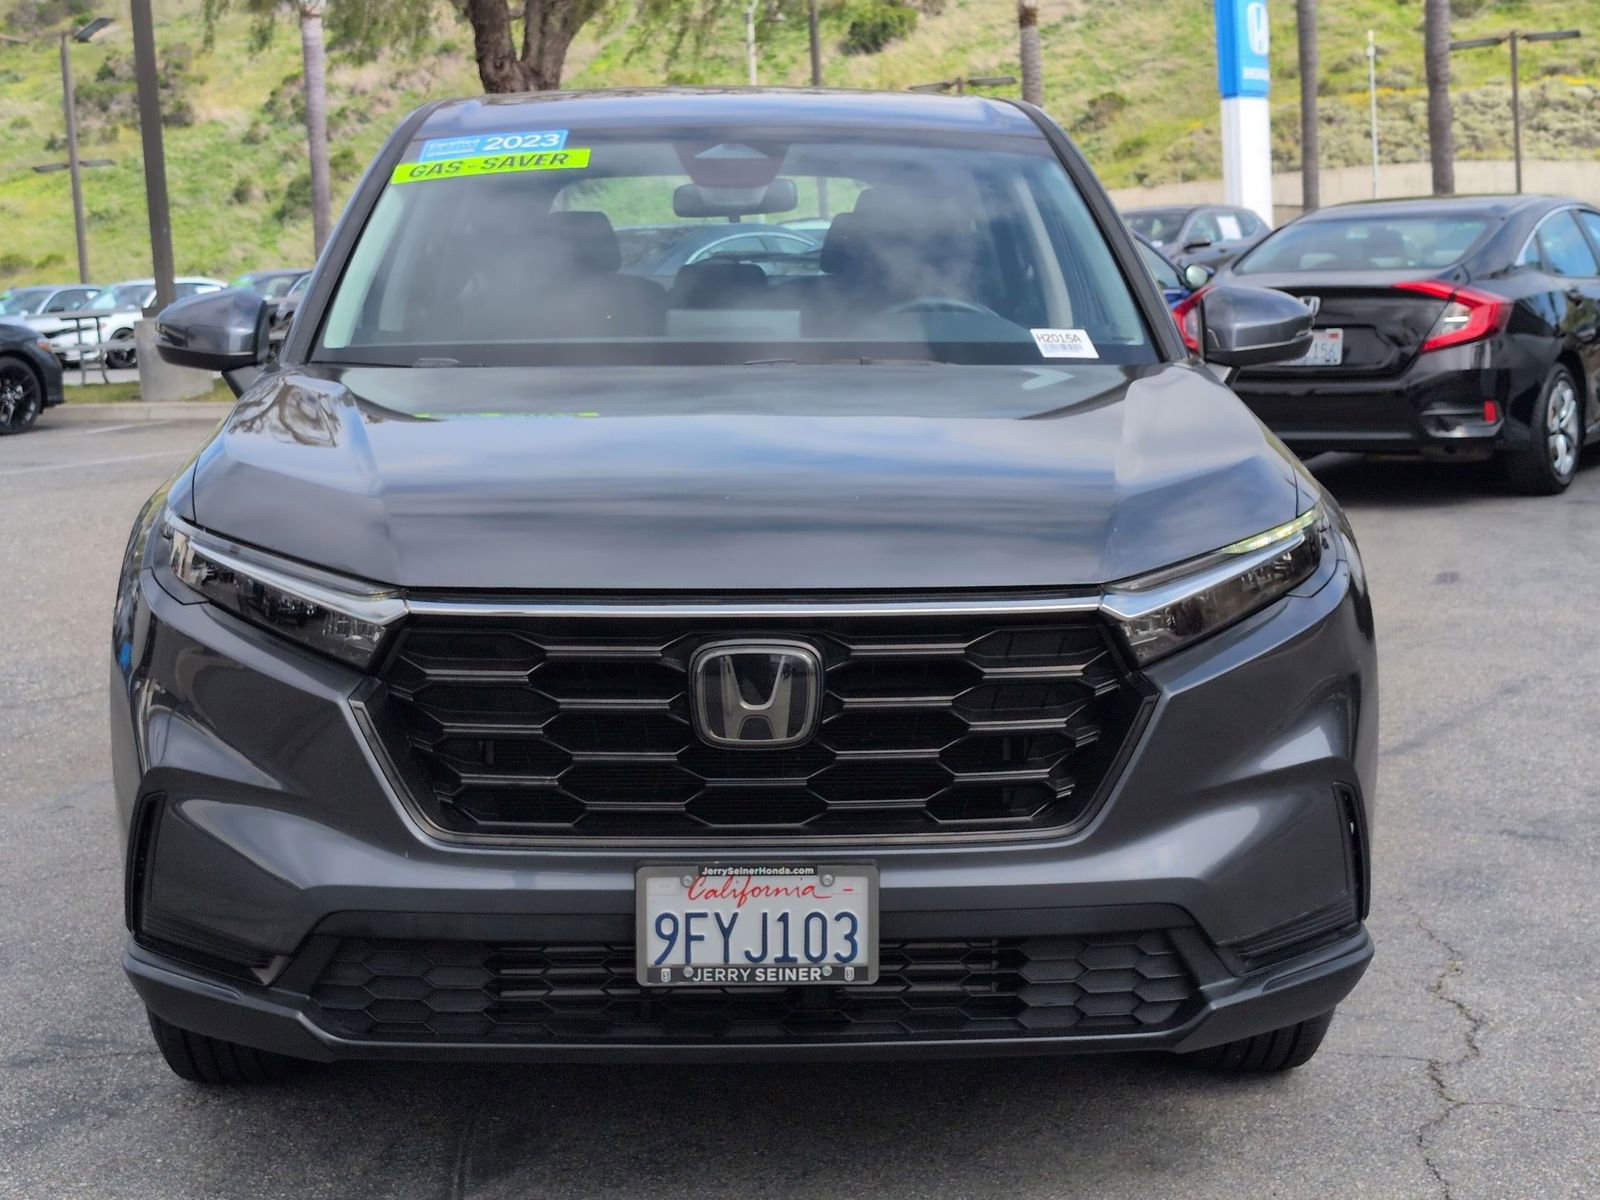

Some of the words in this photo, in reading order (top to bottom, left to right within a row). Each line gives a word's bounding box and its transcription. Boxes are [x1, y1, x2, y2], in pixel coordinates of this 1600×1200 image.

[483, 133, 561, 151] 2023
[408, 160, 464, 178] GAS
[480, 152, 569, 170] SAVER
[1036, 333, 1082, 344] H2015A
[702, 866, 815, 876] JerrySeinerHonda.com
[687, 875, 832, 908] California
[654, 911, 859, 966] 9FYJ103
[692, 968, 752, 982] JERRY
[754, 967, 822, 982] SEINER
